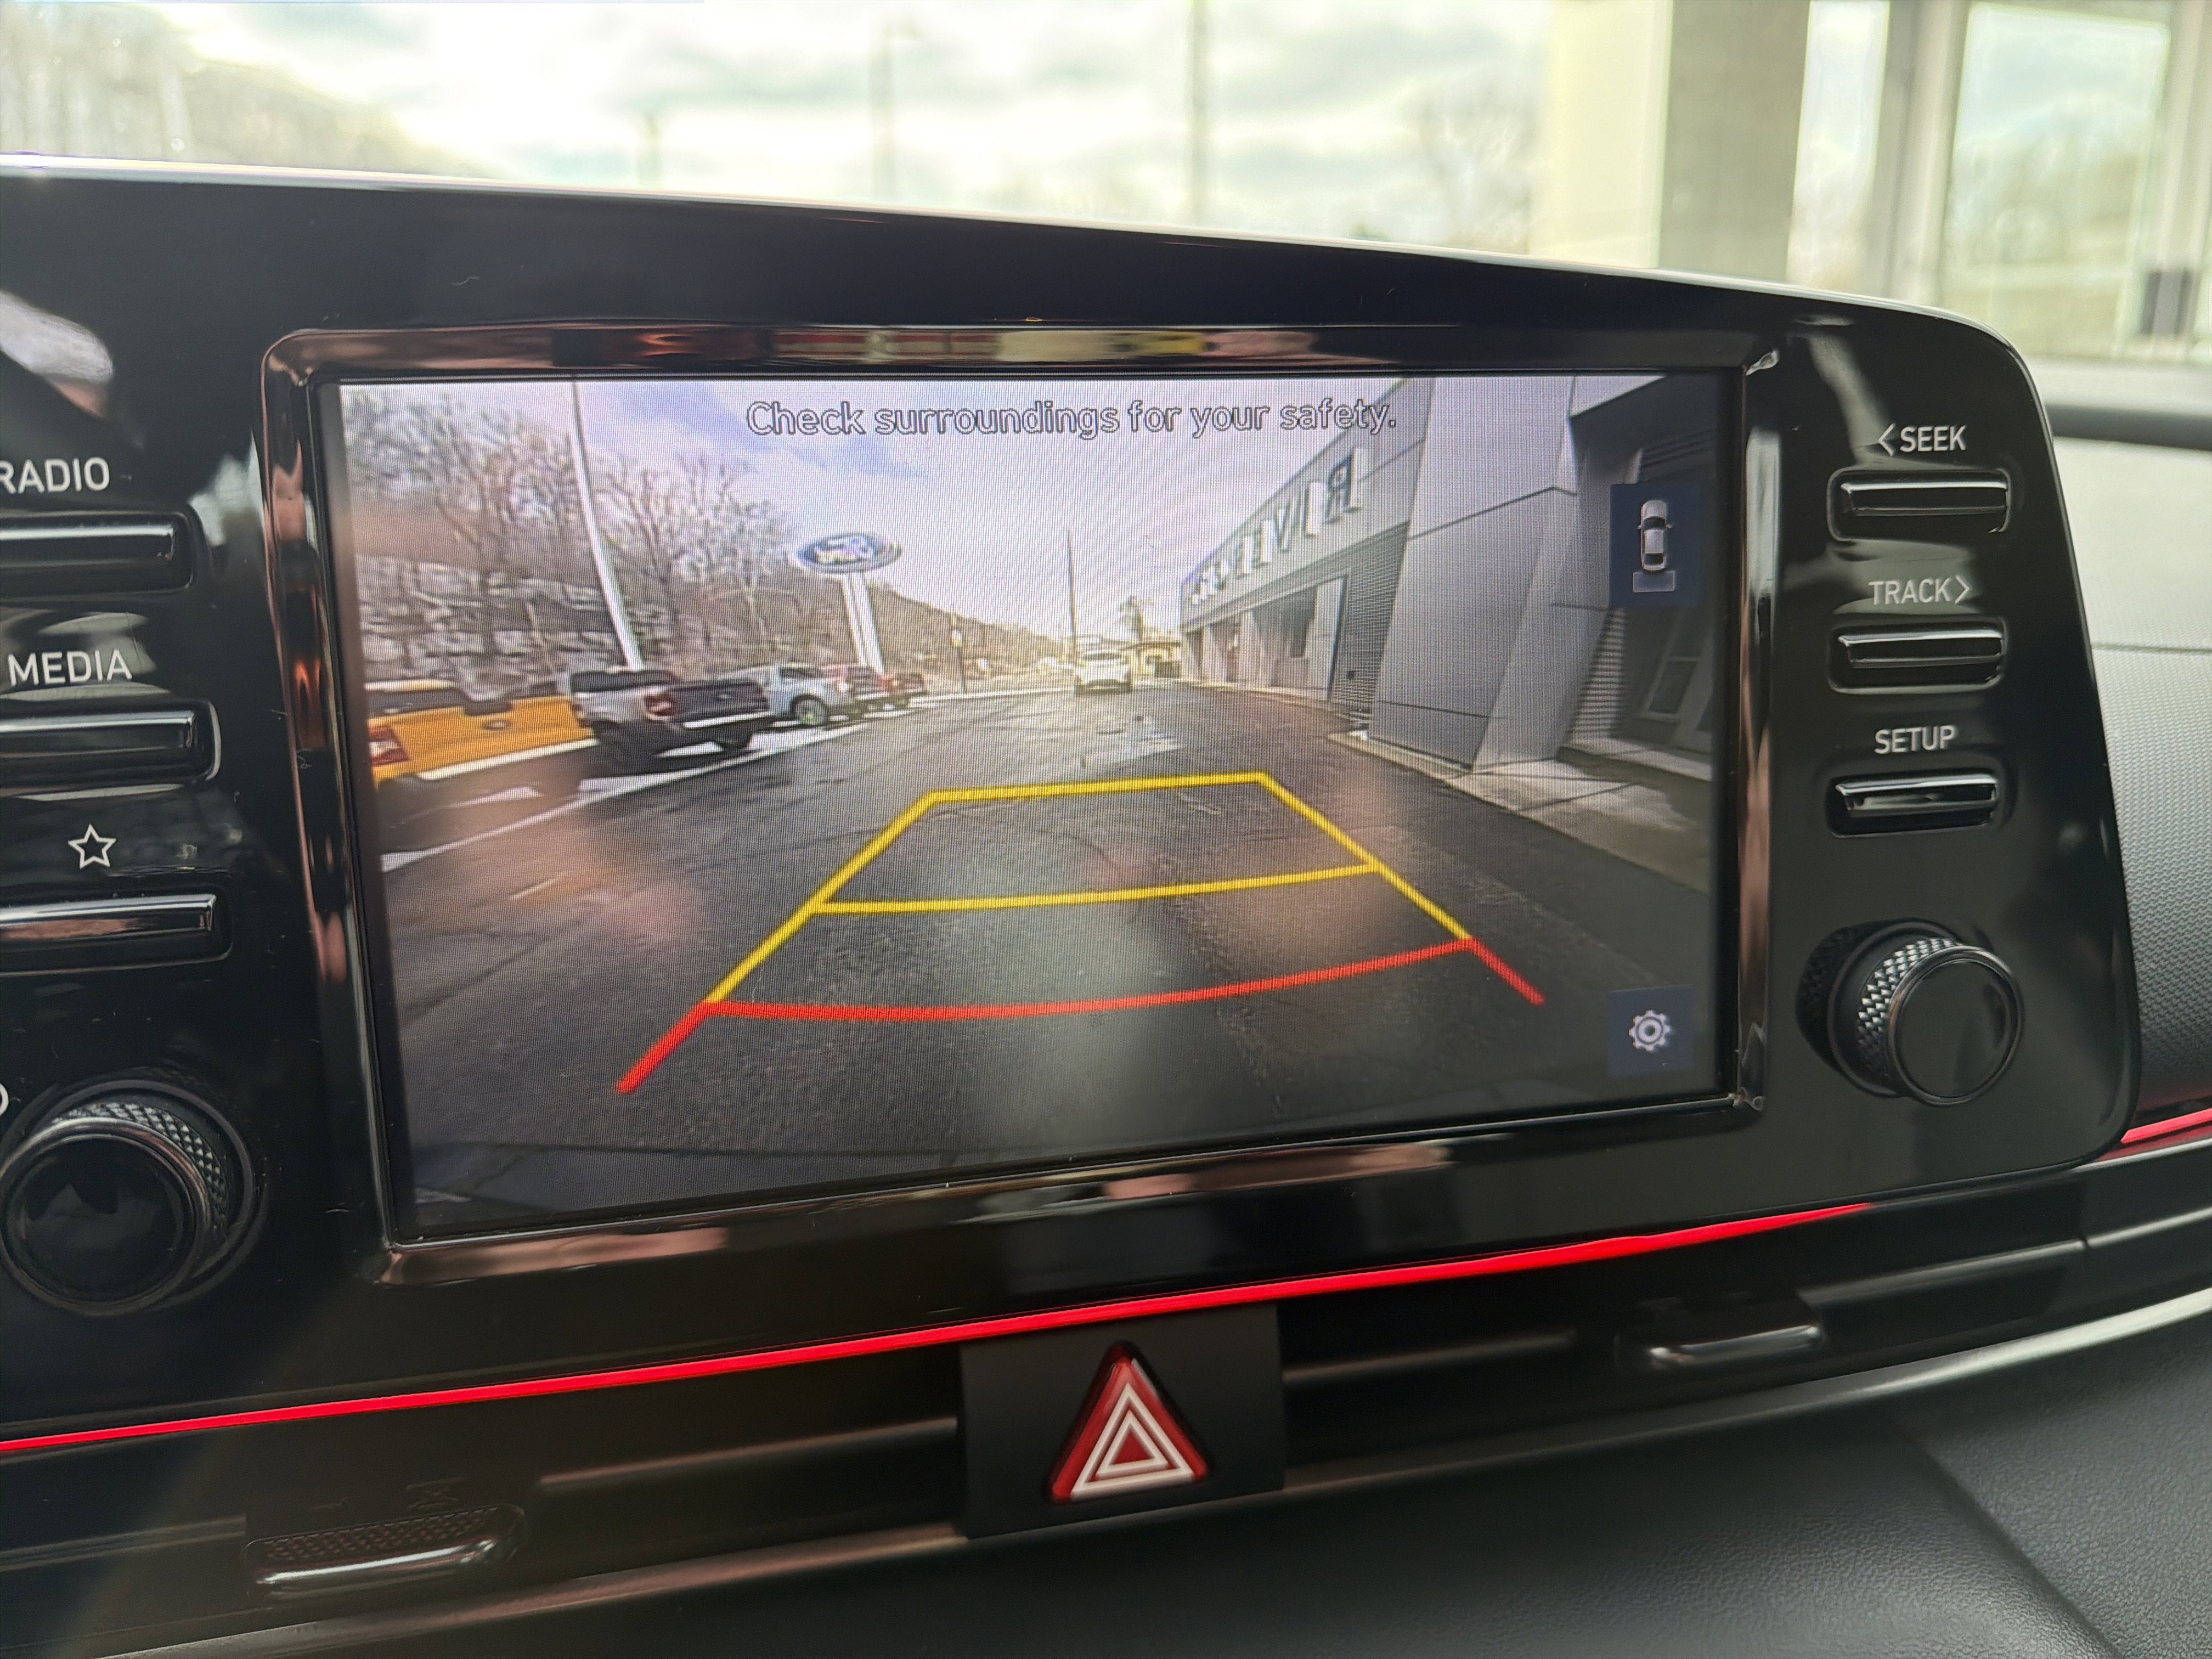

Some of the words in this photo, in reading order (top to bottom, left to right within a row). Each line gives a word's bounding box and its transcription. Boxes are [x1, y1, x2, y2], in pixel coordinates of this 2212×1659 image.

[747, 401, 866, 436] Check
[874, 400, 1120, 440] surroundings
[1128, 400, 1182, 432] for
[1190, 404, 1271, 438] your
[1280, 398, 1397, 435] safety.
[1899, 425, 1967, 452] SEEK
[0, 457, 110, 494] RADIO
[1868, 577, 1952, 605] TRACK
[8, 650, 133, 686] MEDIA
[1874, 725, 1957, 754] SETUP
